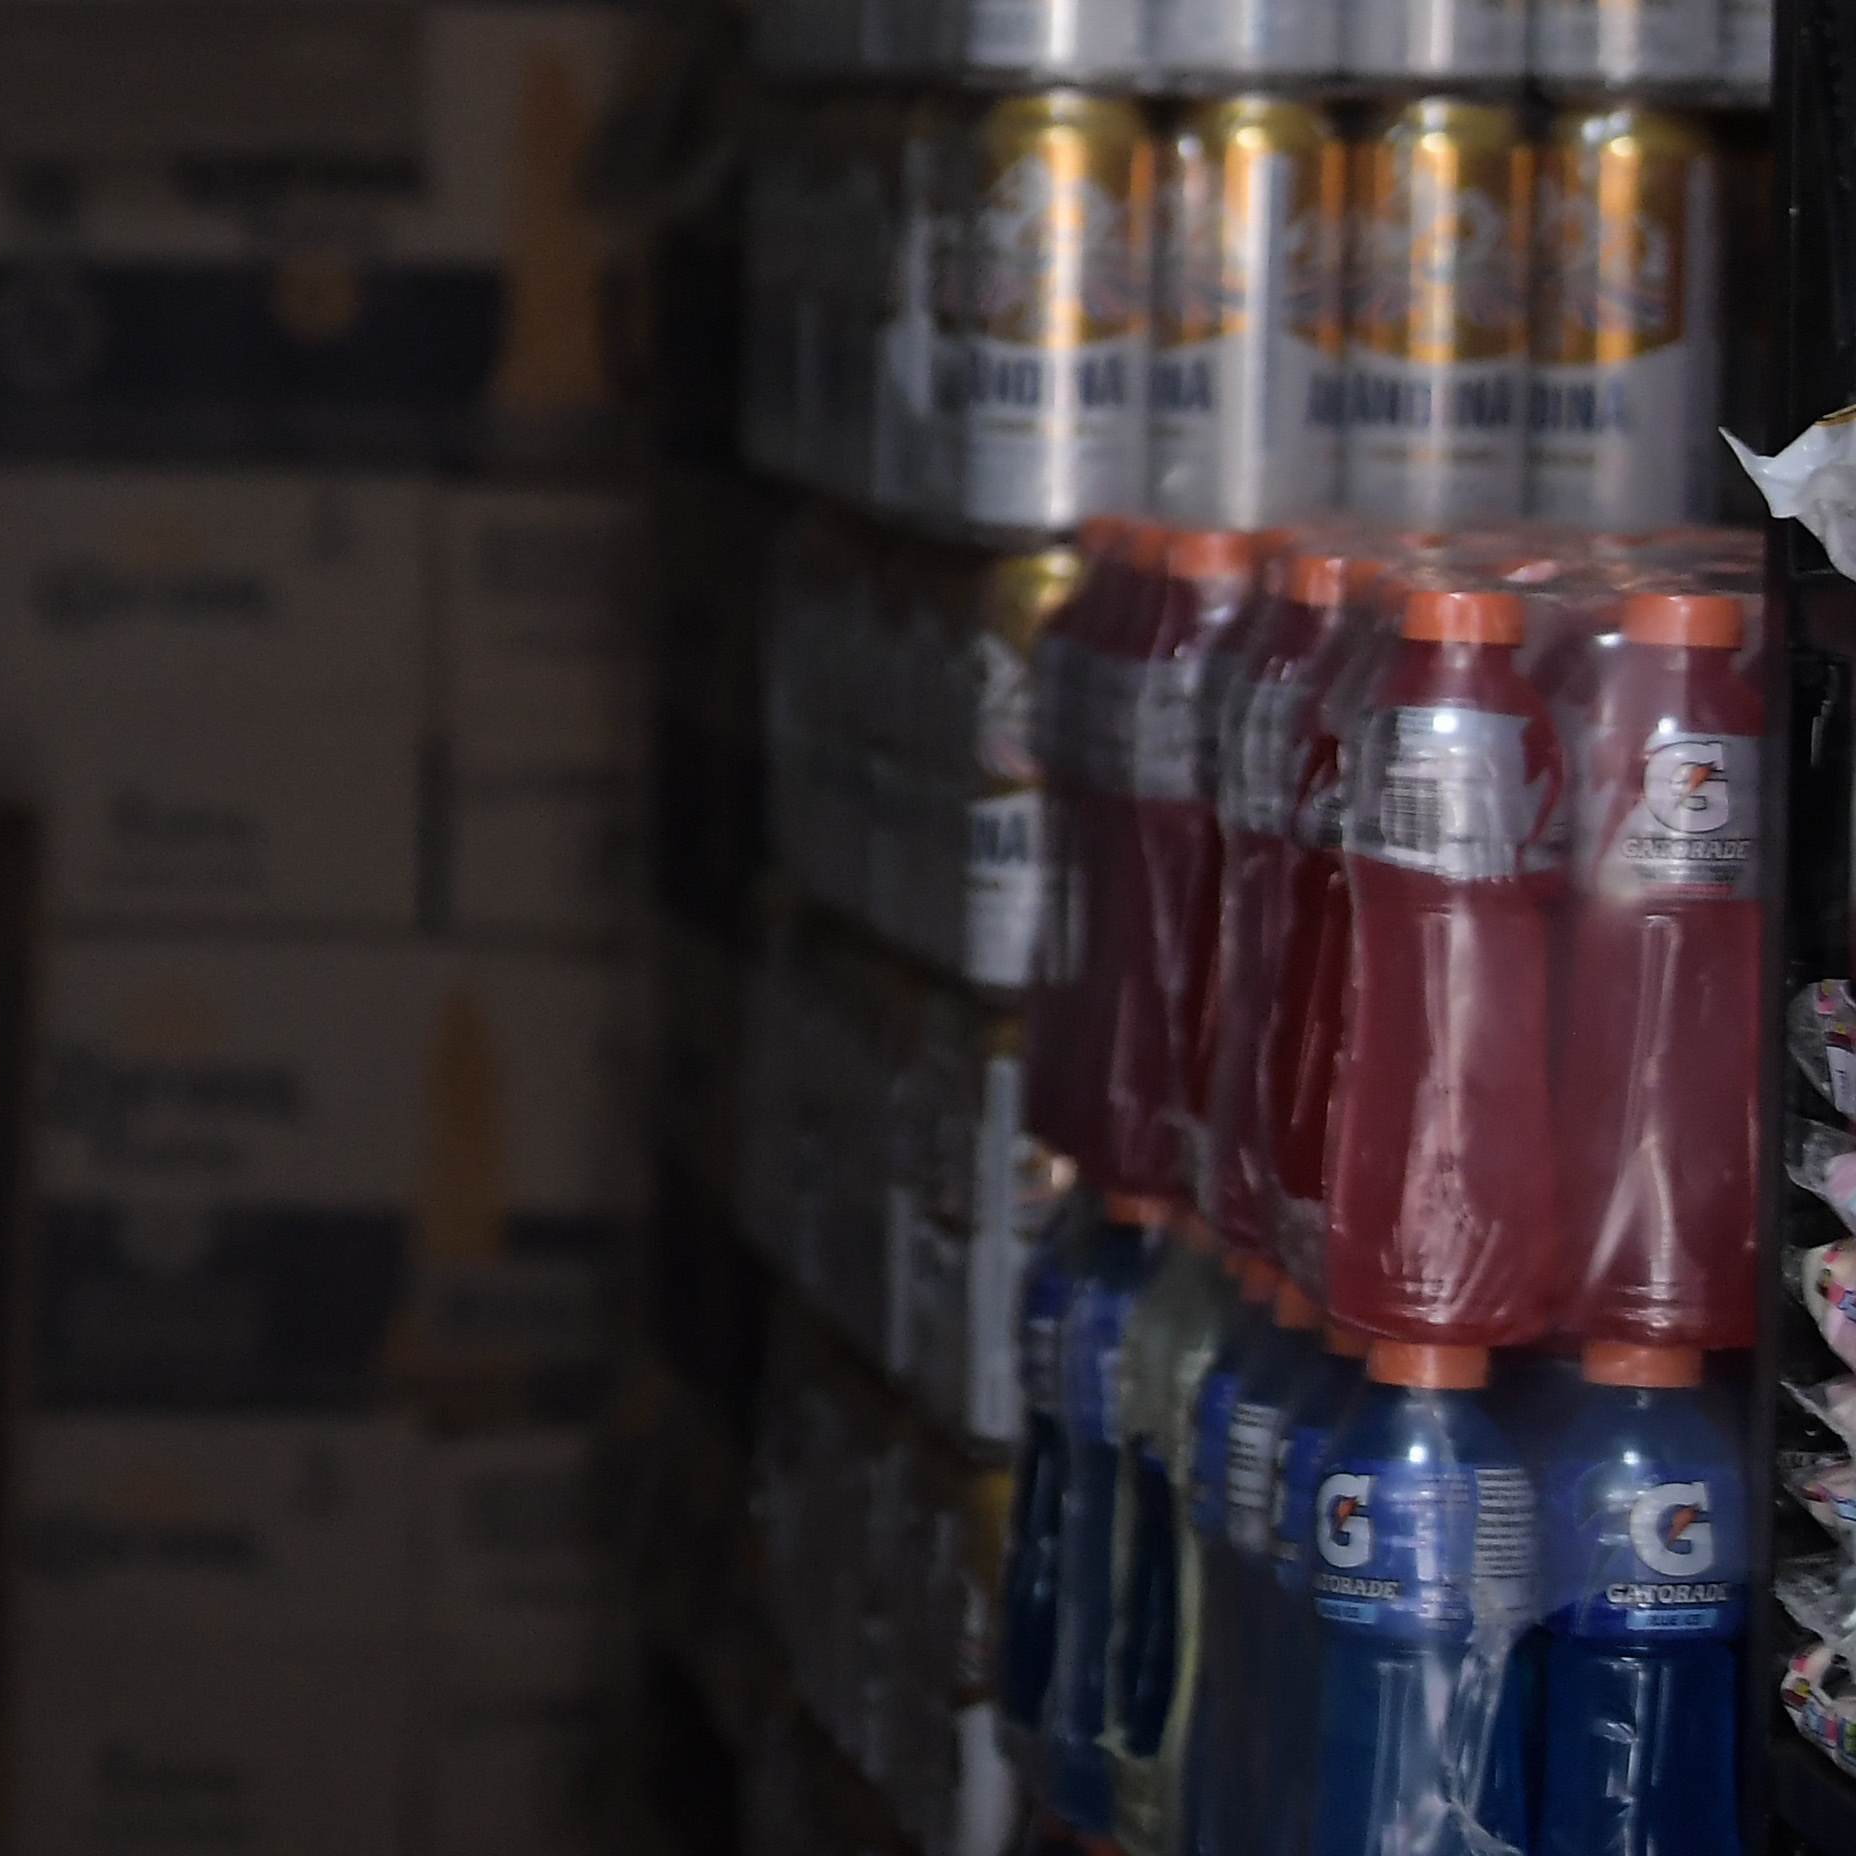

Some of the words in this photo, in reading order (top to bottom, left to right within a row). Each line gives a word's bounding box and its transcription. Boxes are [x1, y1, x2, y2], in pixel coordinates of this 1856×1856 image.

[1643, 741, 1729, 834] G
[1621, 838, 1751, 861] GATORADE
[1316, 1472, 1377, 1568] G
[1629, 1480, 1715, 1576] G
